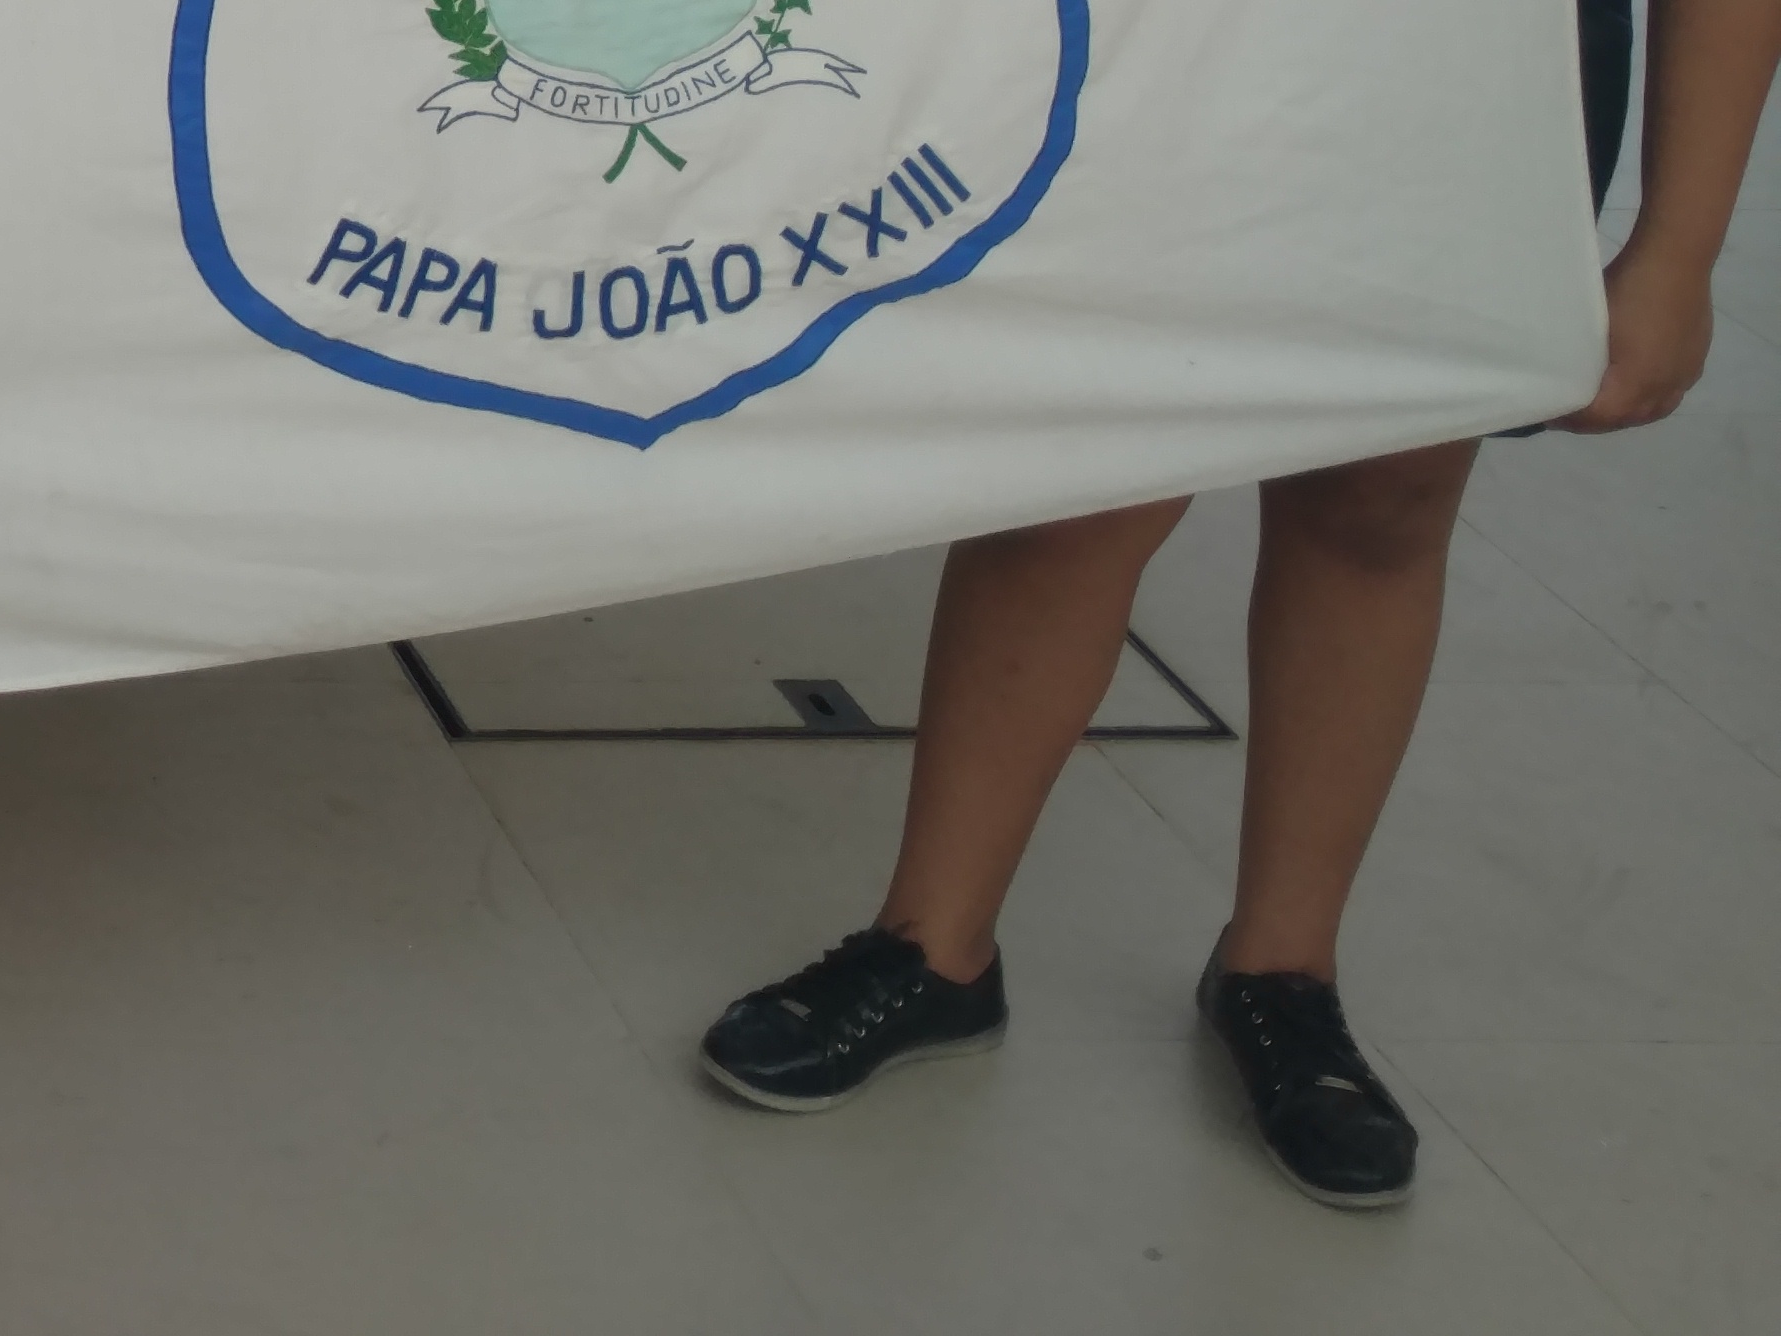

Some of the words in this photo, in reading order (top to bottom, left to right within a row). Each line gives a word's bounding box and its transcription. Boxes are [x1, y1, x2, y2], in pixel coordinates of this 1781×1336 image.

[529, 58, 737, 119] FORTITUDINE
[307, 217, 498, 333] PAPA
[533, 239, 763, 340] JOÃO
[779, 142, 972, 288] XXIII
